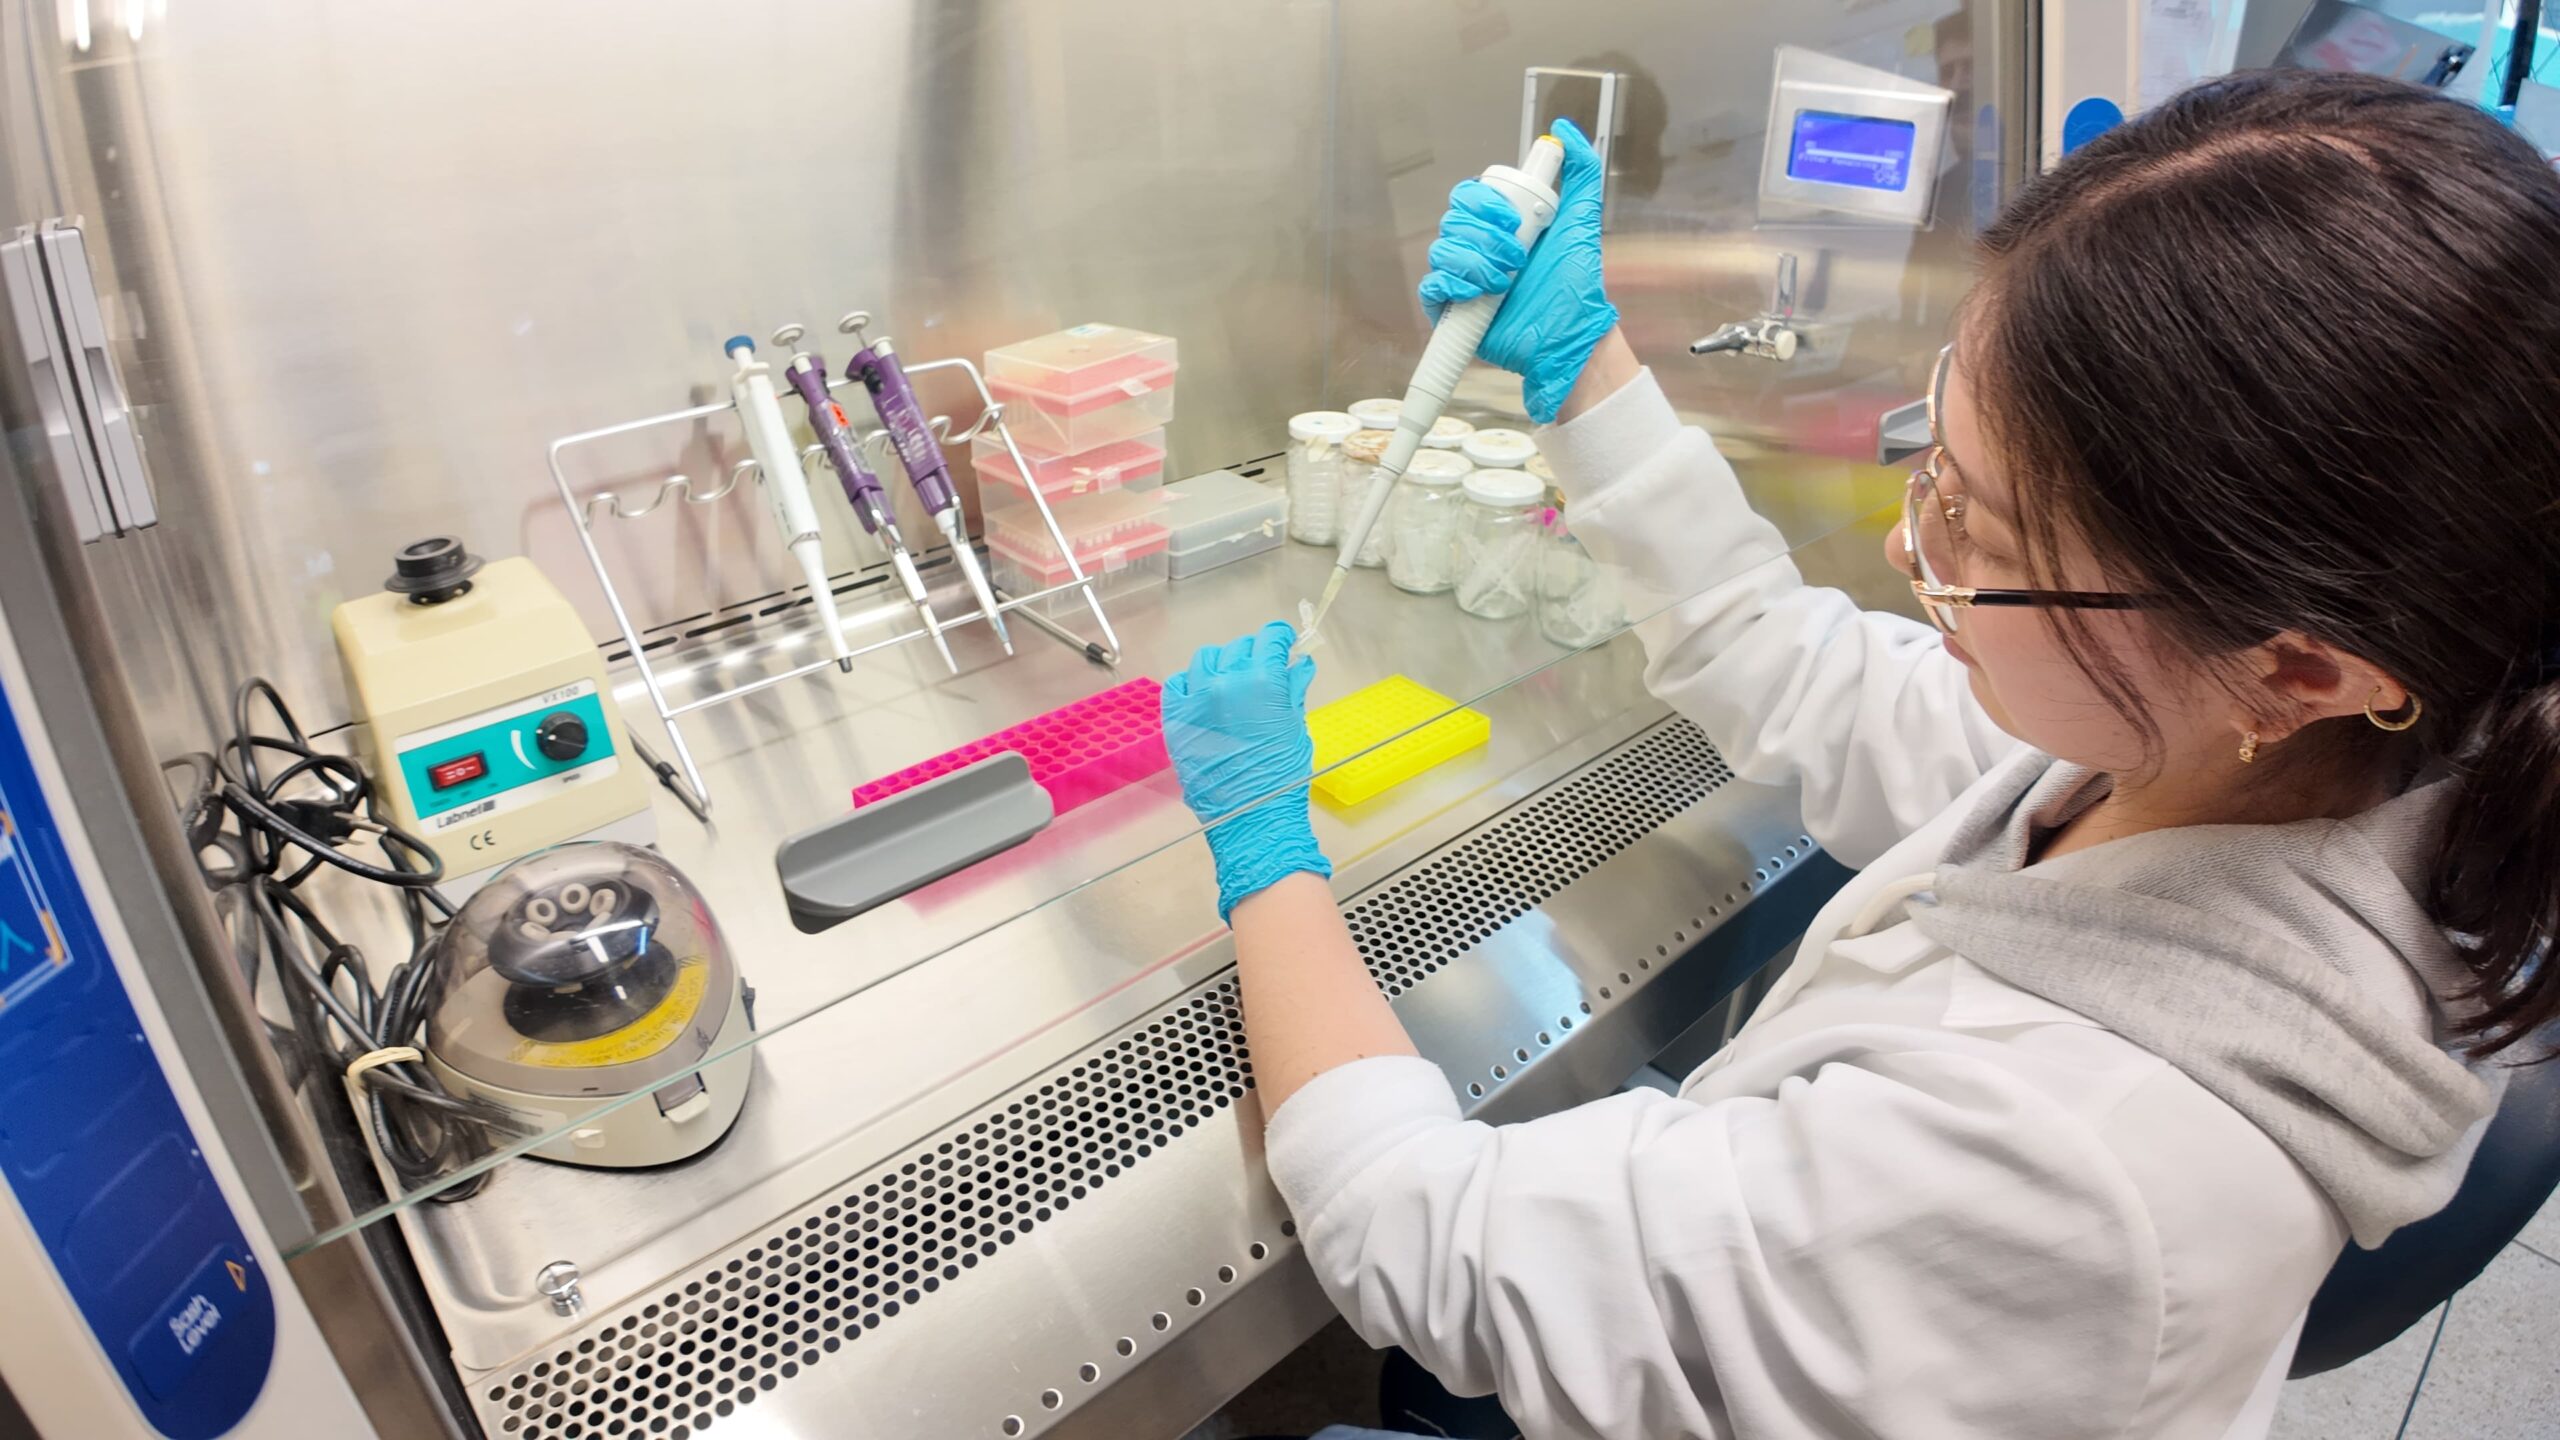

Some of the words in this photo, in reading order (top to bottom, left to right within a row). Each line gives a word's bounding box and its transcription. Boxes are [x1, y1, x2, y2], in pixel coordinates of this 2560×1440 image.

[436, 804, 482, 829] Labnet
[469, 829, 497, 851] CE
[168, 1294, 209, 1338] Sash
[178, 1303, 222, 1355] Level
